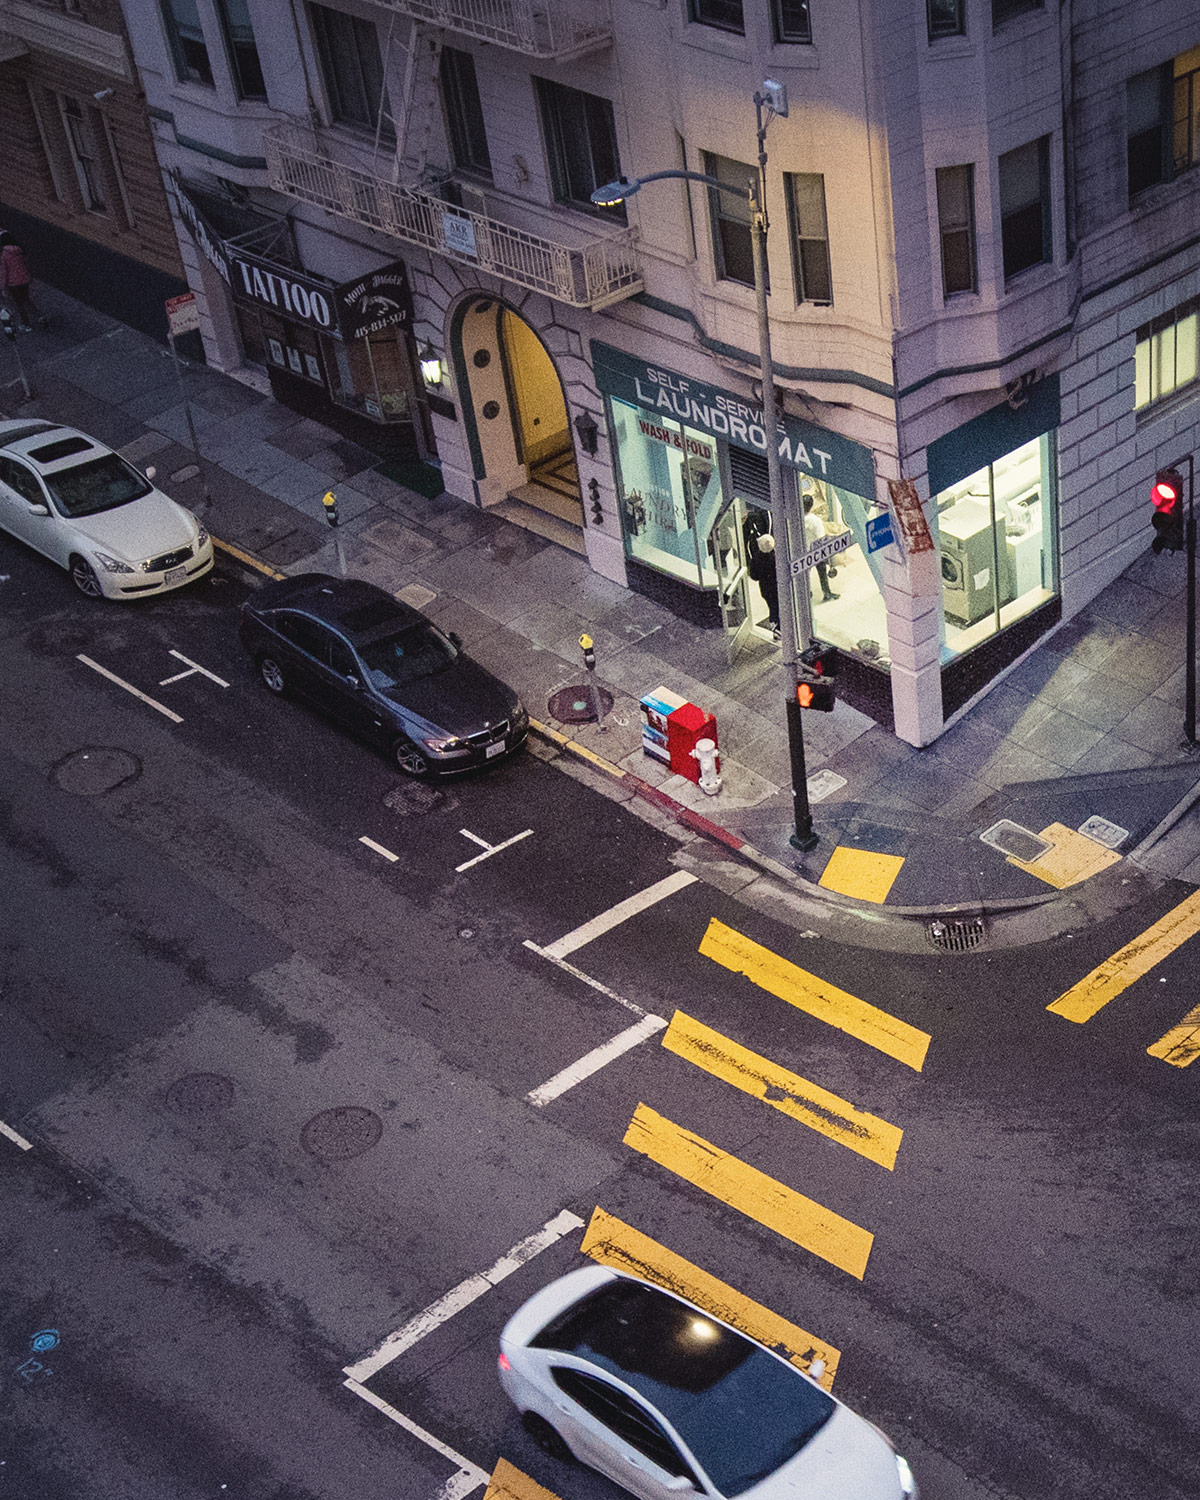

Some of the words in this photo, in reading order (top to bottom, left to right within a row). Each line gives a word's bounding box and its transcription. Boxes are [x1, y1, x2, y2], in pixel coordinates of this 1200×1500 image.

[235, 259, 330, 326] TATTOO
[634, 377, 832, 475] LAUNDROMAT
[646, 368, 689, 394] SELF
[715, 395, 787, 435] SERVIE
[639, 419, 671, 443] WASH
[673, 435, 683, 448] &
[685, 438, 712, 460] FOLD
[792, 535, 848, 574] STOCKTON
